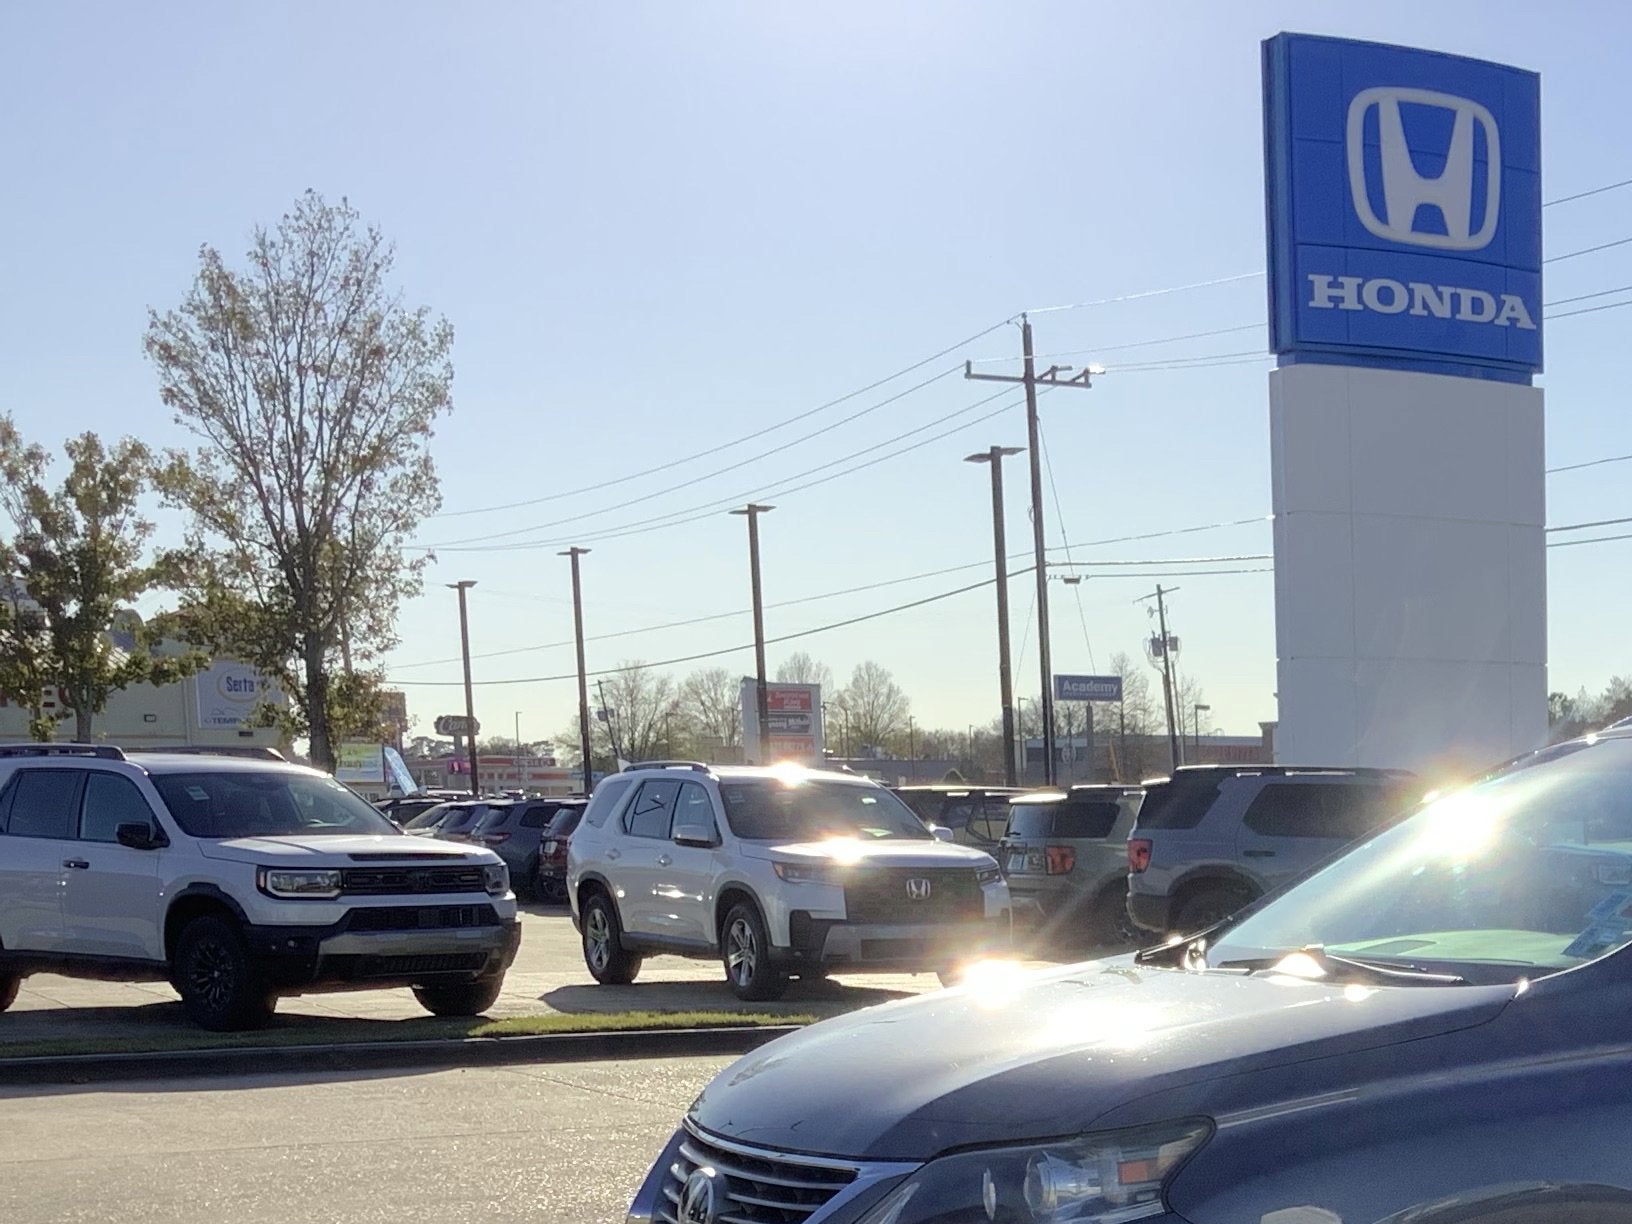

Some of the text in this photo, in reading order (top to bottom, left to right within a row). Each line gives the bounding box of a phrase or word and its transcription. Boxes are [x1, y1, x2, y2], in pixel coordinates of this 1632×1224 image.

[1308, 274, 1537, 330] HONDA
[226, 675, 255, 692] Serta
[1063, 680, 1118, 696] Academy
